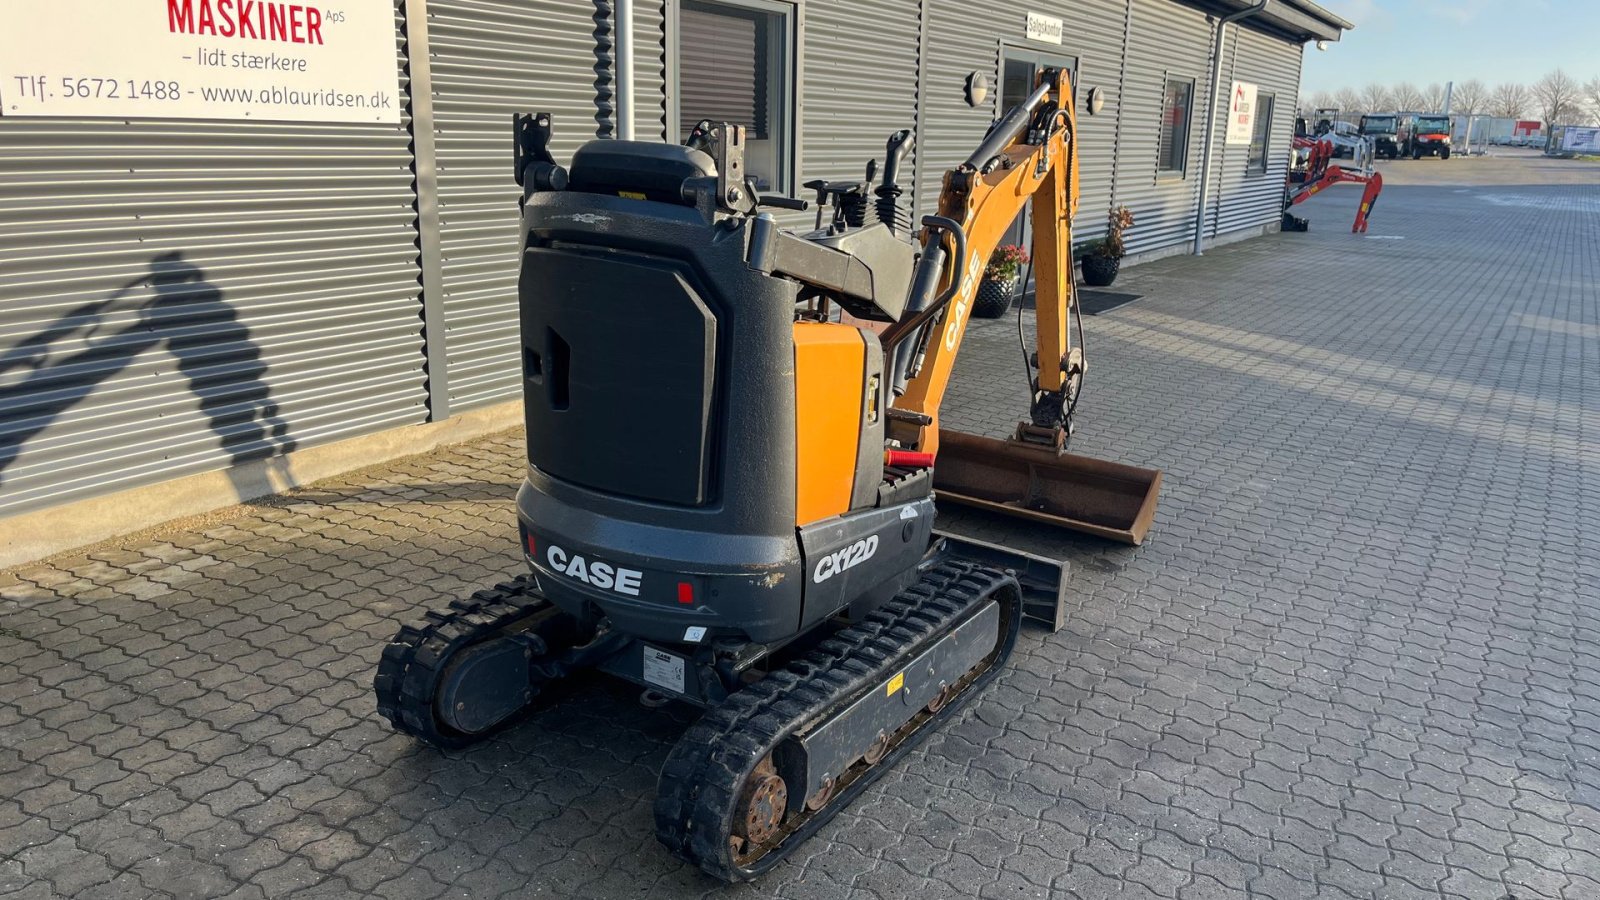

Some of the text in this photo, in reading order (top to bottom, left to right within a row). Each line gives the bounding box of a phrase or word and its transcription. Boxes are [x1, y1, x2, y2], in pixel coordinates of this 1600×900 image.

[167, 0, 345, 45] MASKINER ApS
[1028, 16, 1061, 37] Salgskontor
[198, 47, 227, 67] lidt
[231, 51, 307, 72] stærkere
[14, 75, 53, 103] Tlf.
[62, 77, 119, 99] 5672
[127, 79, 180, 100] 1488
[201, 85, 391, 109] www.ablauridsen.dk
[945, 248, 980, 352] CASE
[546, 545, 643, 596] CASE
[813, 534, 879, 584] CX12D
